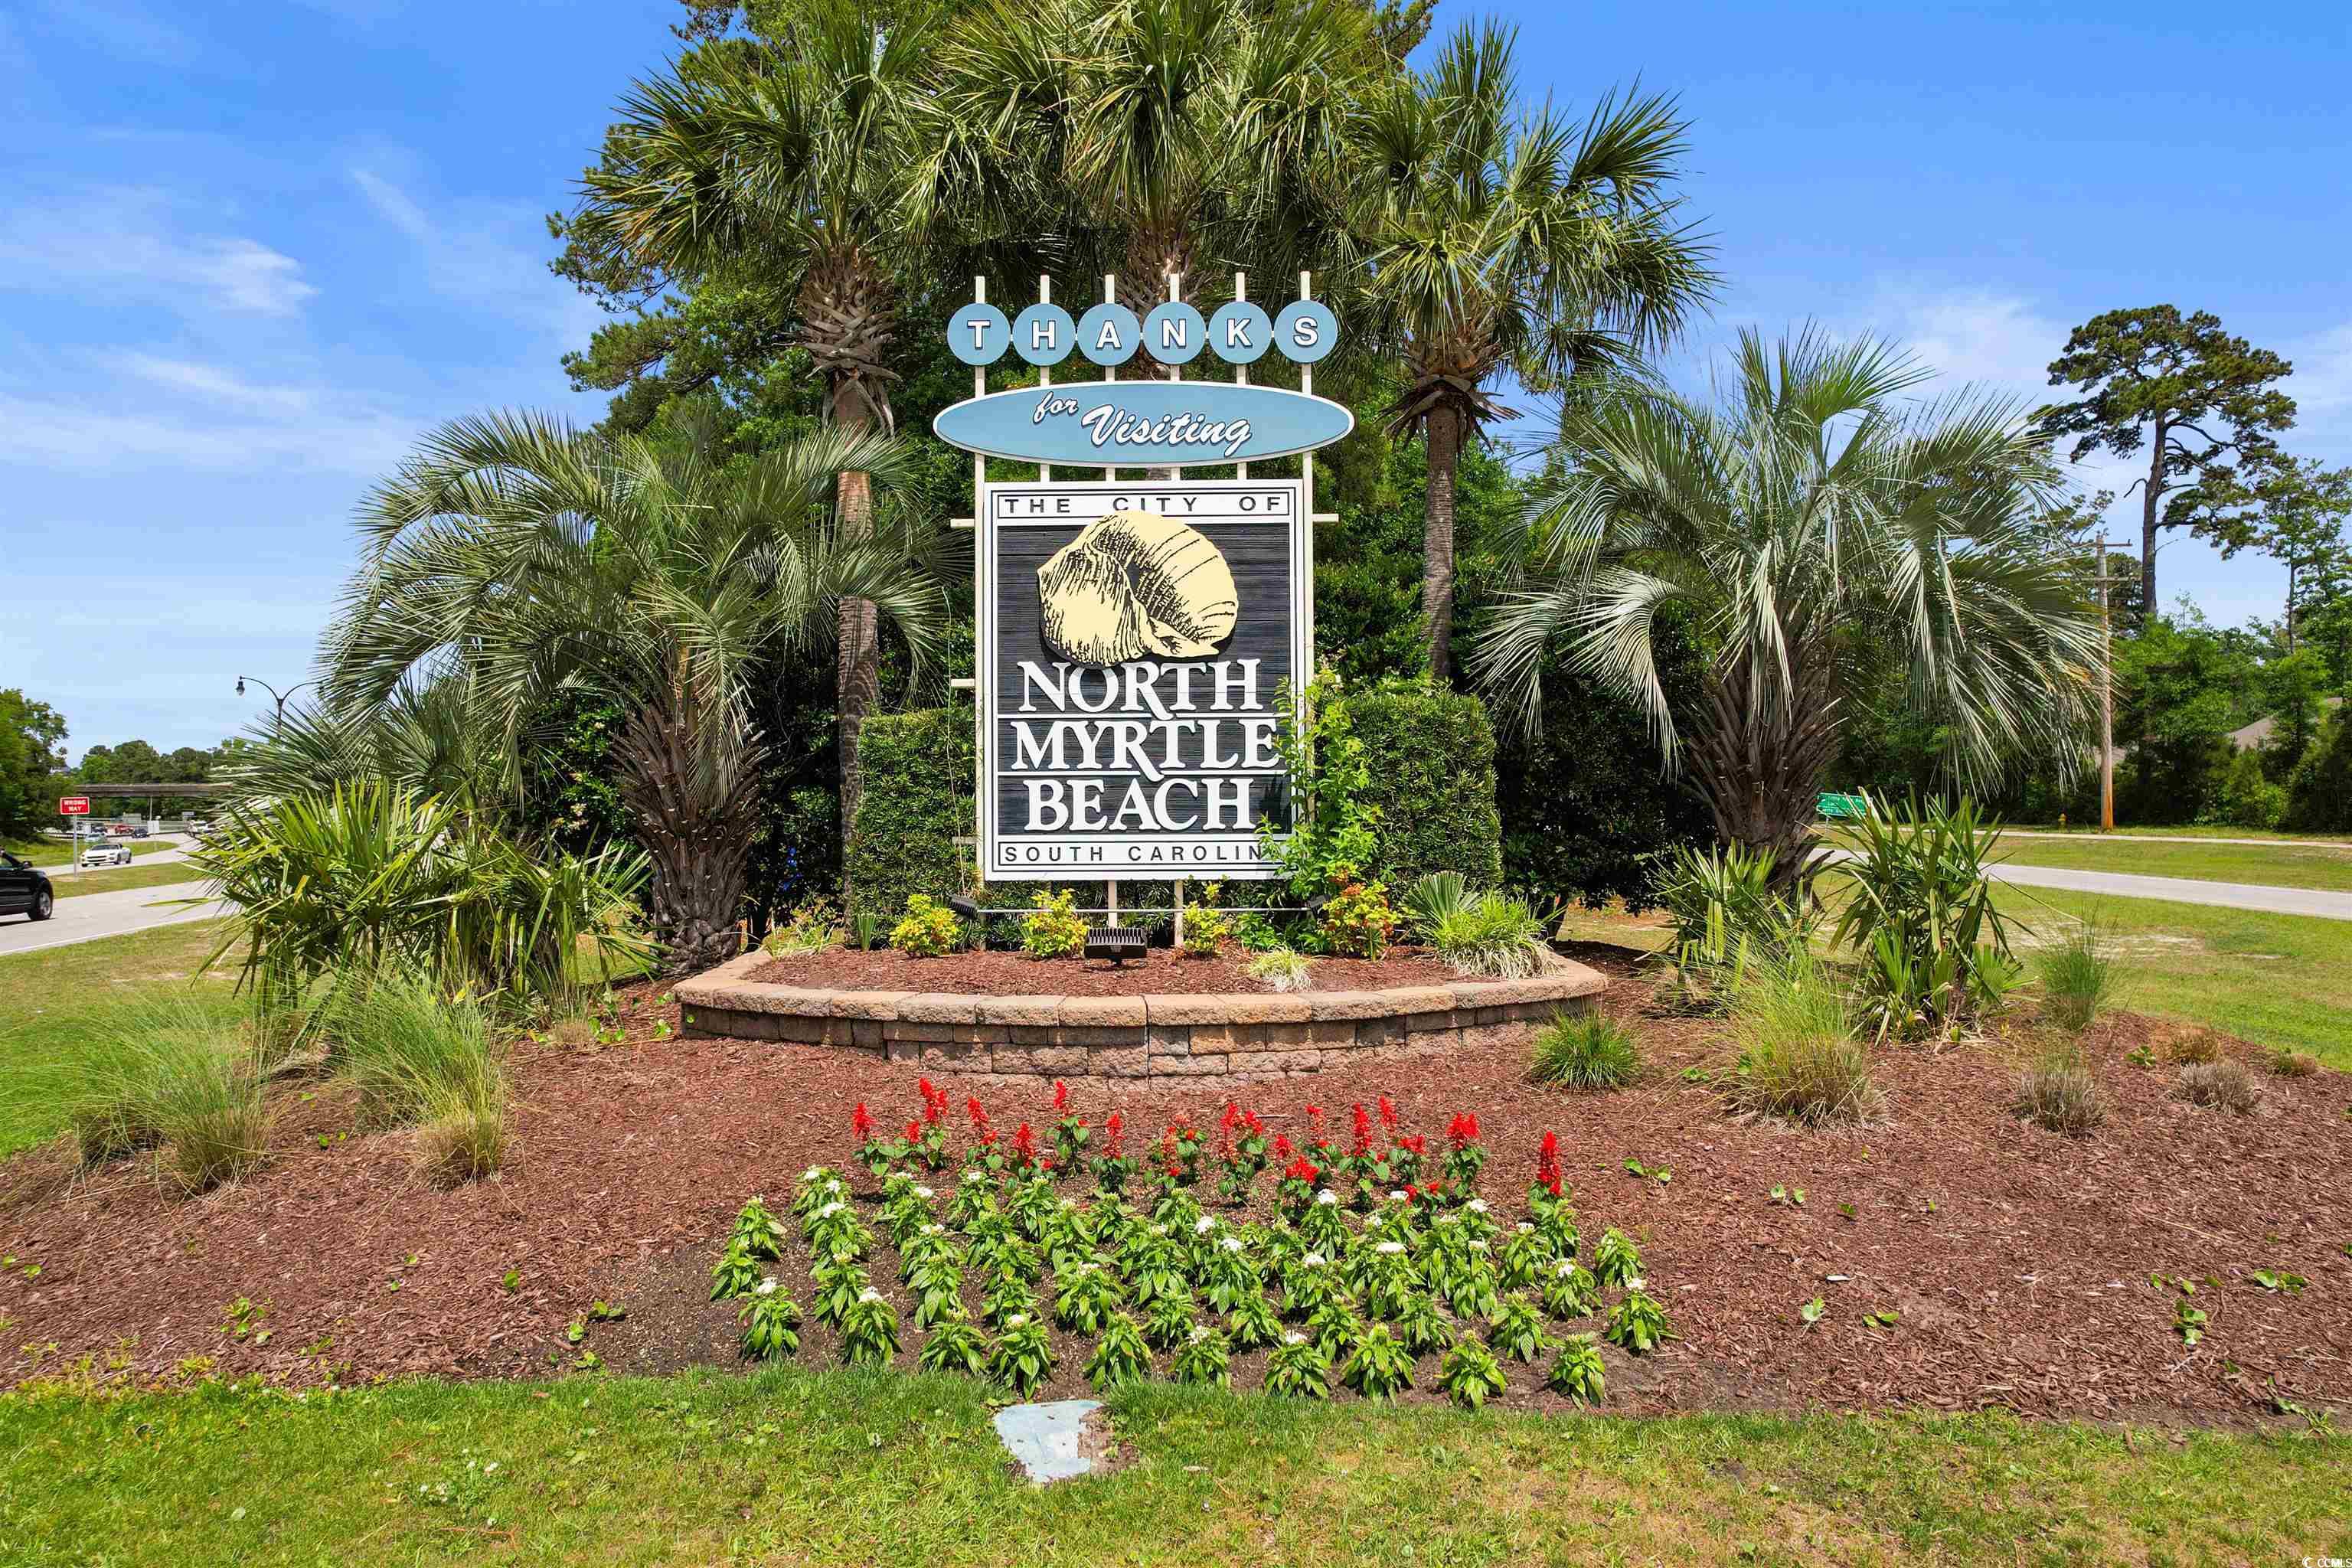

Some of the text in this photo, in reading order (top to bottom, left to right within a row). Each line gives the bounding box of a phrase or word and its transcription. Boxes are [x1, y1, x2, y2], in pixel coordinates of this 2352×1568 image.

[967, 316, 1318, 350] THANKS
[1033, 390, 1252, 458] for Visiting
[1004, 495, 1281, 514] THE CITY OF
[1016, 658, 1263, 720] NORTH
[1010, 718, 1281, 782] MYRTLE
[1022, 777, 1256, 831] BEACH
[1004, 845, 1263, 861] SOUTH CAROLIN
